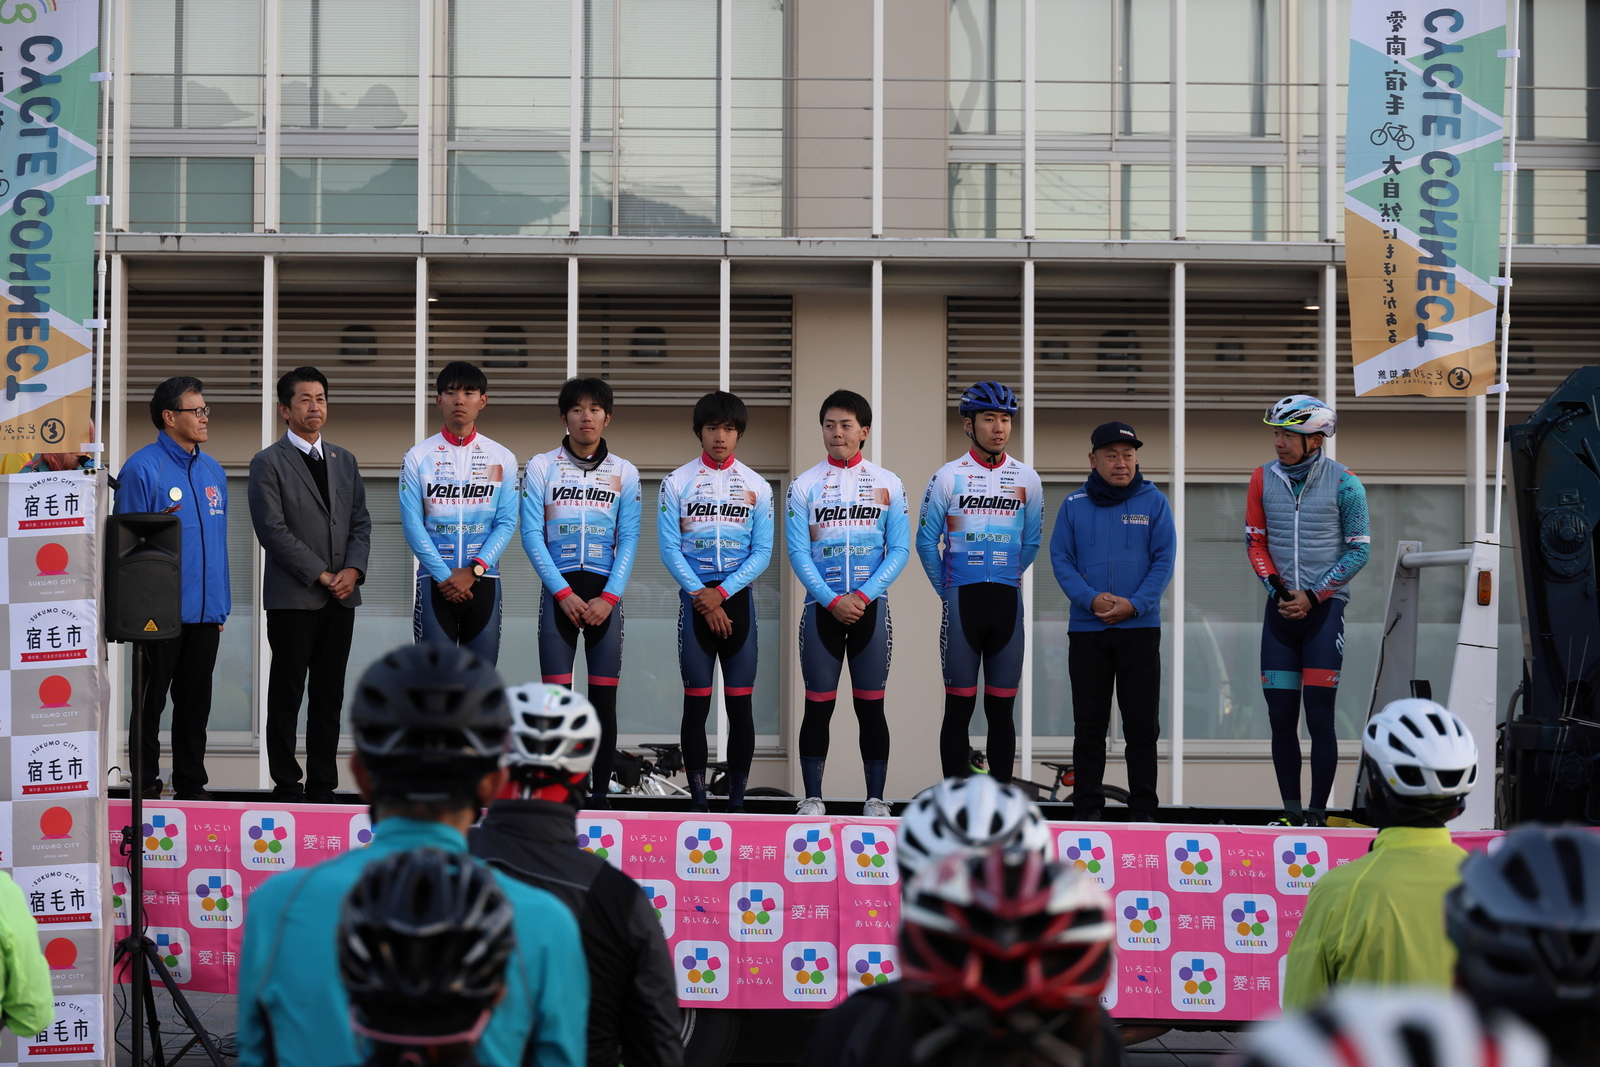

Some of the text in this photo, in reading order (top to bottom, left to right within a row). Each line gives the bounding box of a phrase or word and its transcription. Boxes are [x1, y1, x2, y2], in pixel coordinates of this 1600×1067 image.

[29, 476, 76, 490] SUKUMO CITY
[24, 492, 79, 518] 宿毛市
[556, 500, 610, 509] MATSUYAMA
[959, 495, 1021, 510] Velolien
[963, 508, 1016, 516] MATSUYAMA
[820, 520, 876, 528] MATSUYAMA
[30, 608, 76, 622] SUKUMO CITY
[26, 624, 81, 650] 宿毛市
[31, 740, 78, 754] SUKUMO CITY
[28, 757, 82, 782] 宿毛市
[193, 824, 232, 832] いろこい
[110, 830, 123, 844] 南
[194, 844, 232, 853] あいなん
[252, 856, 285, 865] ainan
[629, 855, 666, 863] あいなん
[687, 866, 720, 875] ainan
[795, 867, 828, 876] ainan
[856, 870, 889, 879] ainan
[1229, 869, 1266, 878] あいなん
[33, 871, 79, 885] SUKUMO CITY
[1179, 878, 1212, 886] ainan
[30, 888, 85, 913] 宿毛市
[683, 896, 721, 904] いろこい
[854, 899, 892, 908] いろこい
[200, 914, 233, 922] ainan
[682, 916, 720, 924] あいなん
[855, 920, 892, 928] あいなん
[1128, 936, 1161, 944] ainan
[1235, 939, 1268, 947] ainan
[736, 977, 774, 985] あいなん
[686, 986, 719, 995] ainan
[1125, 985, 1162, 994] あいなん
[1183, 997, 1216, 1005] ainan
[69, 1003, 83, 1013] CITY
